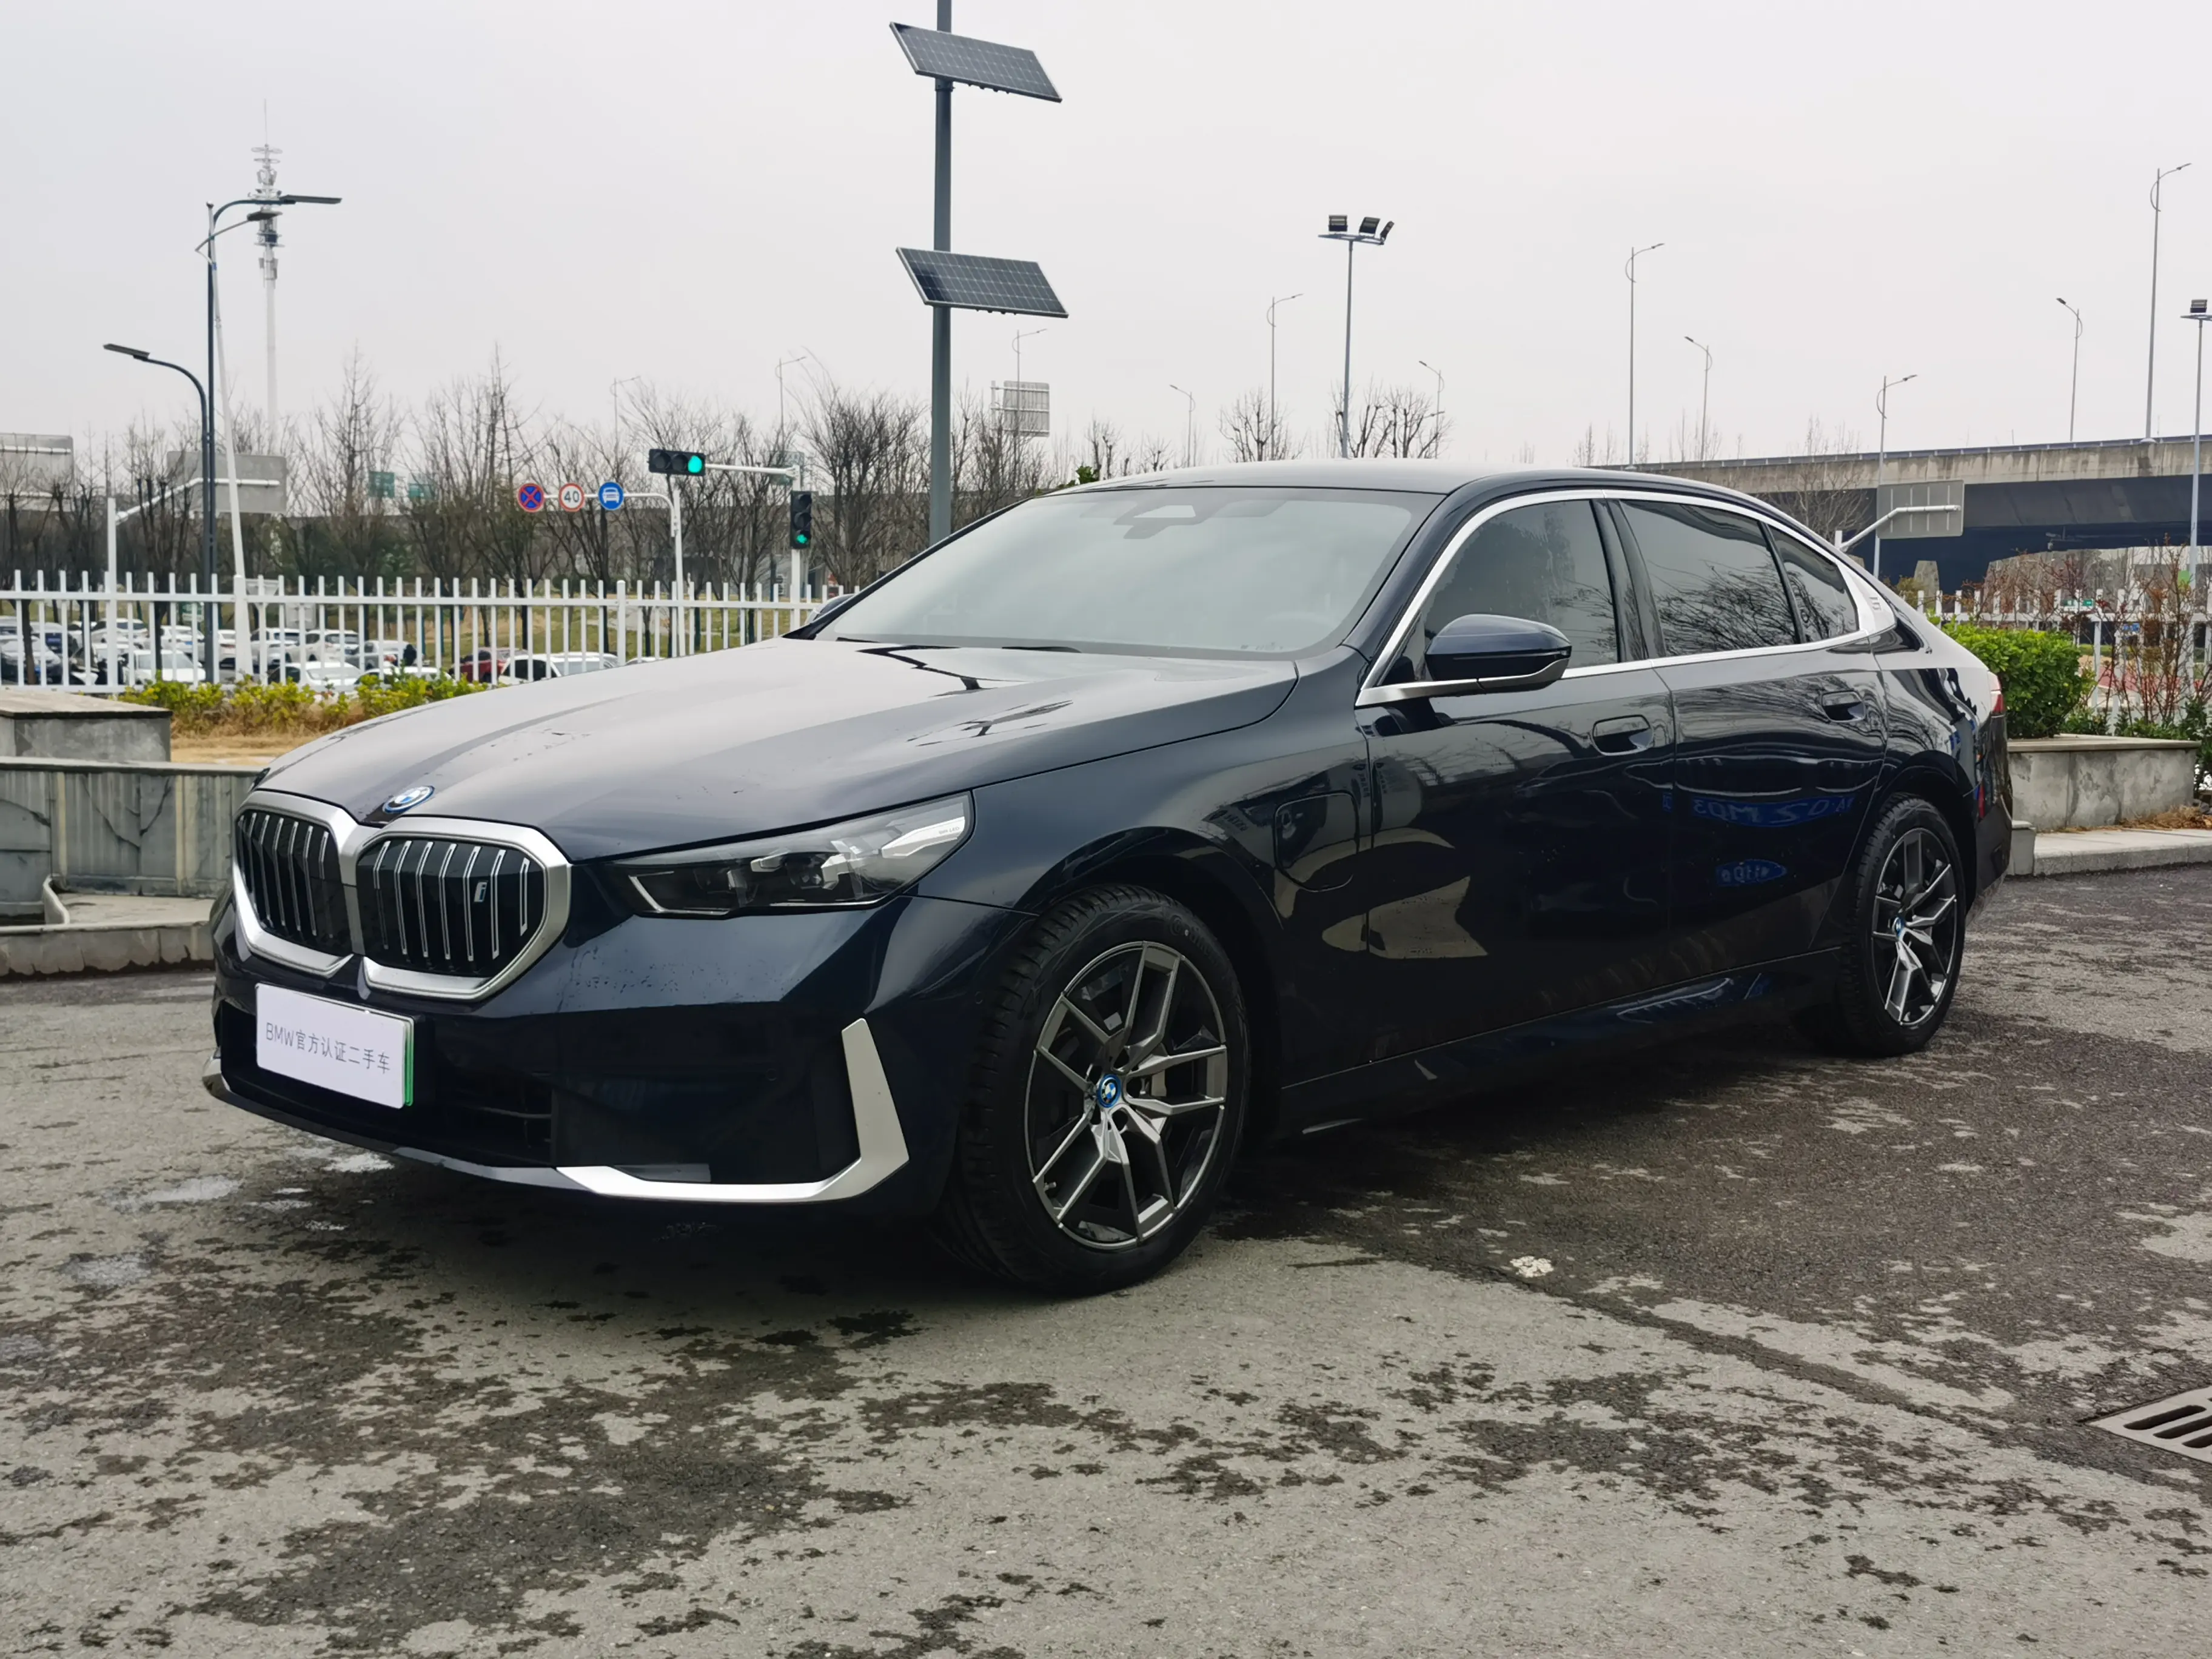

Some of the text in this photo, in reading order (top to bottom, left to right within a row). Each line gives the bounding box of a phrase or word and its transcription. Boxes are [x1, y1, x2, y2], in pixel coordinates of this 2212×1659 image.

[565, 491, 580, 503] 40
[266, 1022, 390, 1074] BMW官方认证二手车
